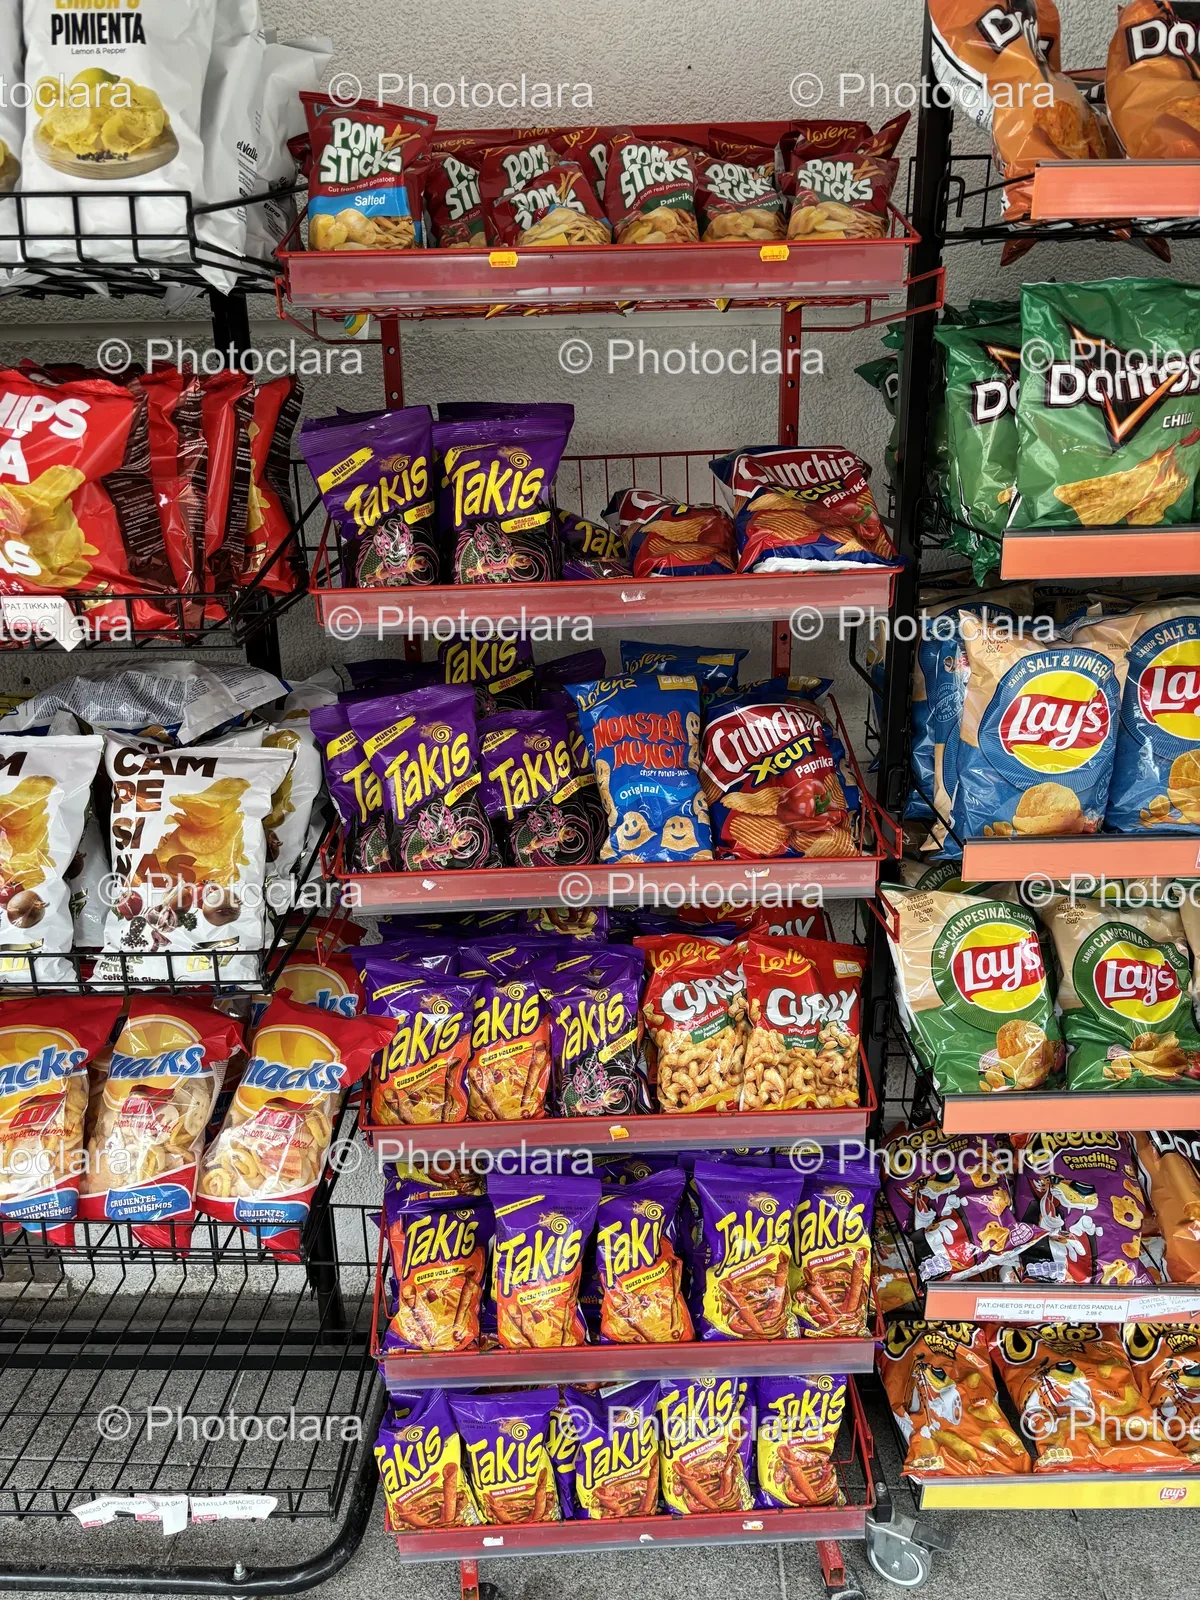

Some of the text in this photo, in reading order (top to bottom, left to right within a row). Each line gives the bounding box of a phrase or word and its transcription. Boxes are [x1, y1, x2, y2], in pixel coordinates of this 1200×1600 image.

[51, 12, 146, 45] PIMIENTA
[102, 47, 126, 55] Pepper
[332, 118, 385, 154] POM
[807, 126, 857, 143] Lorenz
[503, 144, 549, 187] POM
[621, 145, 668, 168] POM
[806, 160, 854, 182] POM
[369, 176, 395, 187] potatoes
[355, 195, 386, 206] Salted
[332, 458, 355, 476] NUEVO
[344, 456, 427, 535] Takis
[452, 460, 545, 527] Takis
[823, 477, 867, 508] Paprika
[1136, 623, 1197, 658] SABOR SALT &
[446, 636, 517, 684] Takis
[1008, 655, 1071, 689] SABOR SALT &
[577, 678, 637, 711] Lorenz
[375, 726, 397, 742] NUEVO
[1008, 696, 1101, 750] Lay's
[113, 746, 218, 777] CAM
[614, 740, 689, 770] MUNCH
[795, 756, 834, 778] Paprika
[384, 732, 470, 820] Takis
[489, 740, 571, 820] Takis
[619, 784, 659, 800] Original
[113, 779, 165, 813] PE
[113, 816, 146, 850] SI
[113, 853, 197, 888] NAS
[938, 908, 1011, 959] SABOR CAMPESINAS
[1082, 927, 1150, 964] SABOR CAMPESINAS
[651, 941, 721, 974] Lorenz
[963, 937, 1041, 991] Lay's
[662, 967, 746, 1022] CURLY
[1105, 960, 1175, 1006] Lay's
[709, 1006, 725, 1018] Classic
[767, 988, 858, 1027] CURLY
[556, 993, 624, 1069] Takis
[498, 1045, 524, 1058] VOLCANO
[396, 1062, 439, 1088] QUESO VOLCANO
[1063, 1154, 1118, 1168] Pandilla
[1069, 1162, 1117, 1172] Fantasmas
[111, 1195, 156, 1207] CRUJIENTES
[240, 1209, 285, 1217] CRUJIENTES
[403, 1213, 479, 1278] Takis
[715, 1210, 791, 1275] Takis
[793, 1200, 865, 1266] Takis
[416, 1272, 433, 1282] QUESO
[497, 1229, 582, 1296] Takis
[625, 1268, 665, 1290] QUESO VOLCANO
[656, 1380, 732, 1457] Takis
[769, 1385, 846, 1434] Takis
[466, 1433, 543, 1490] Takis
[582, 1421, 654, 1487] Takis
[1161, 1487, 1187, 1500] Lay's
